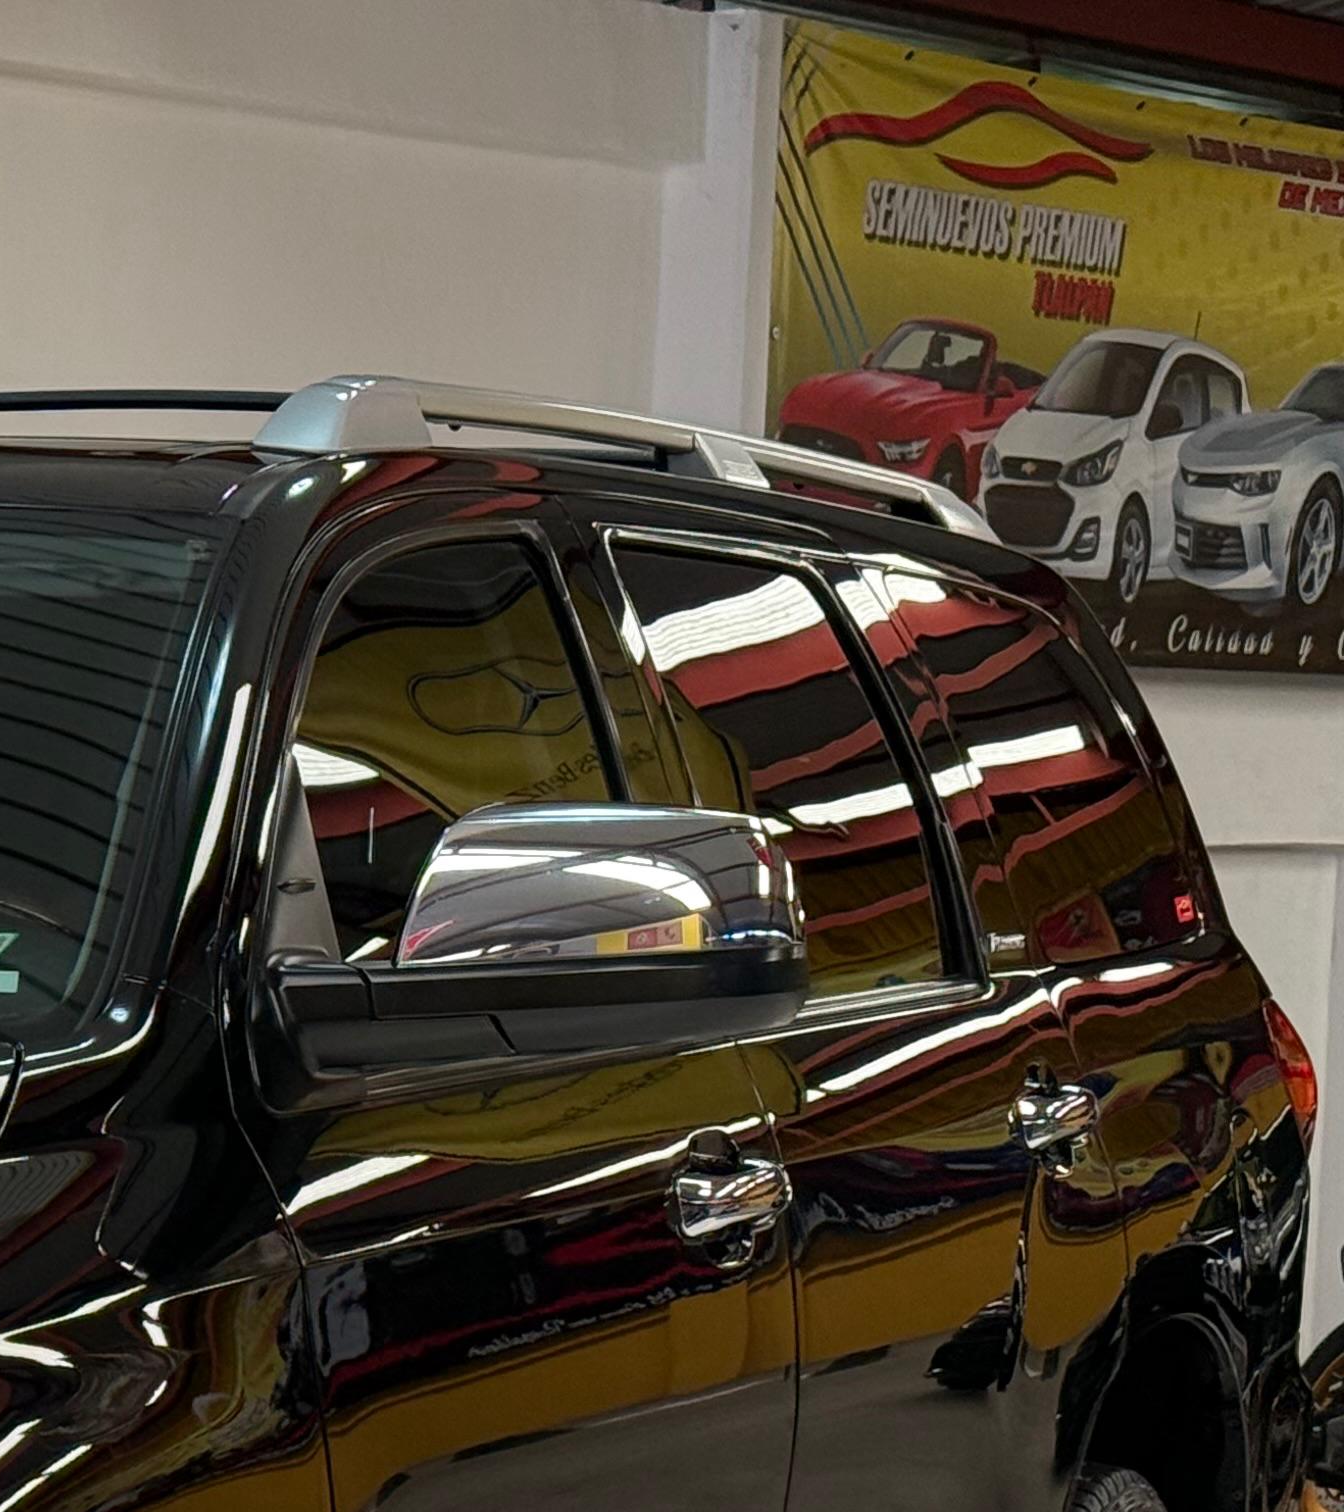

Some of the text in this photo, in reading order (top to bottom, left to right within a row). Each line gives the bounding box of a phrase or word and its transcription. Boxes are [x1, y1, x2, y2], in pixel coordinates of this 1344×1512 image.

[863, 180, 1126, 277] SEMINUEVOS PREMIUM
[1298, 634, 1313, 667] y
